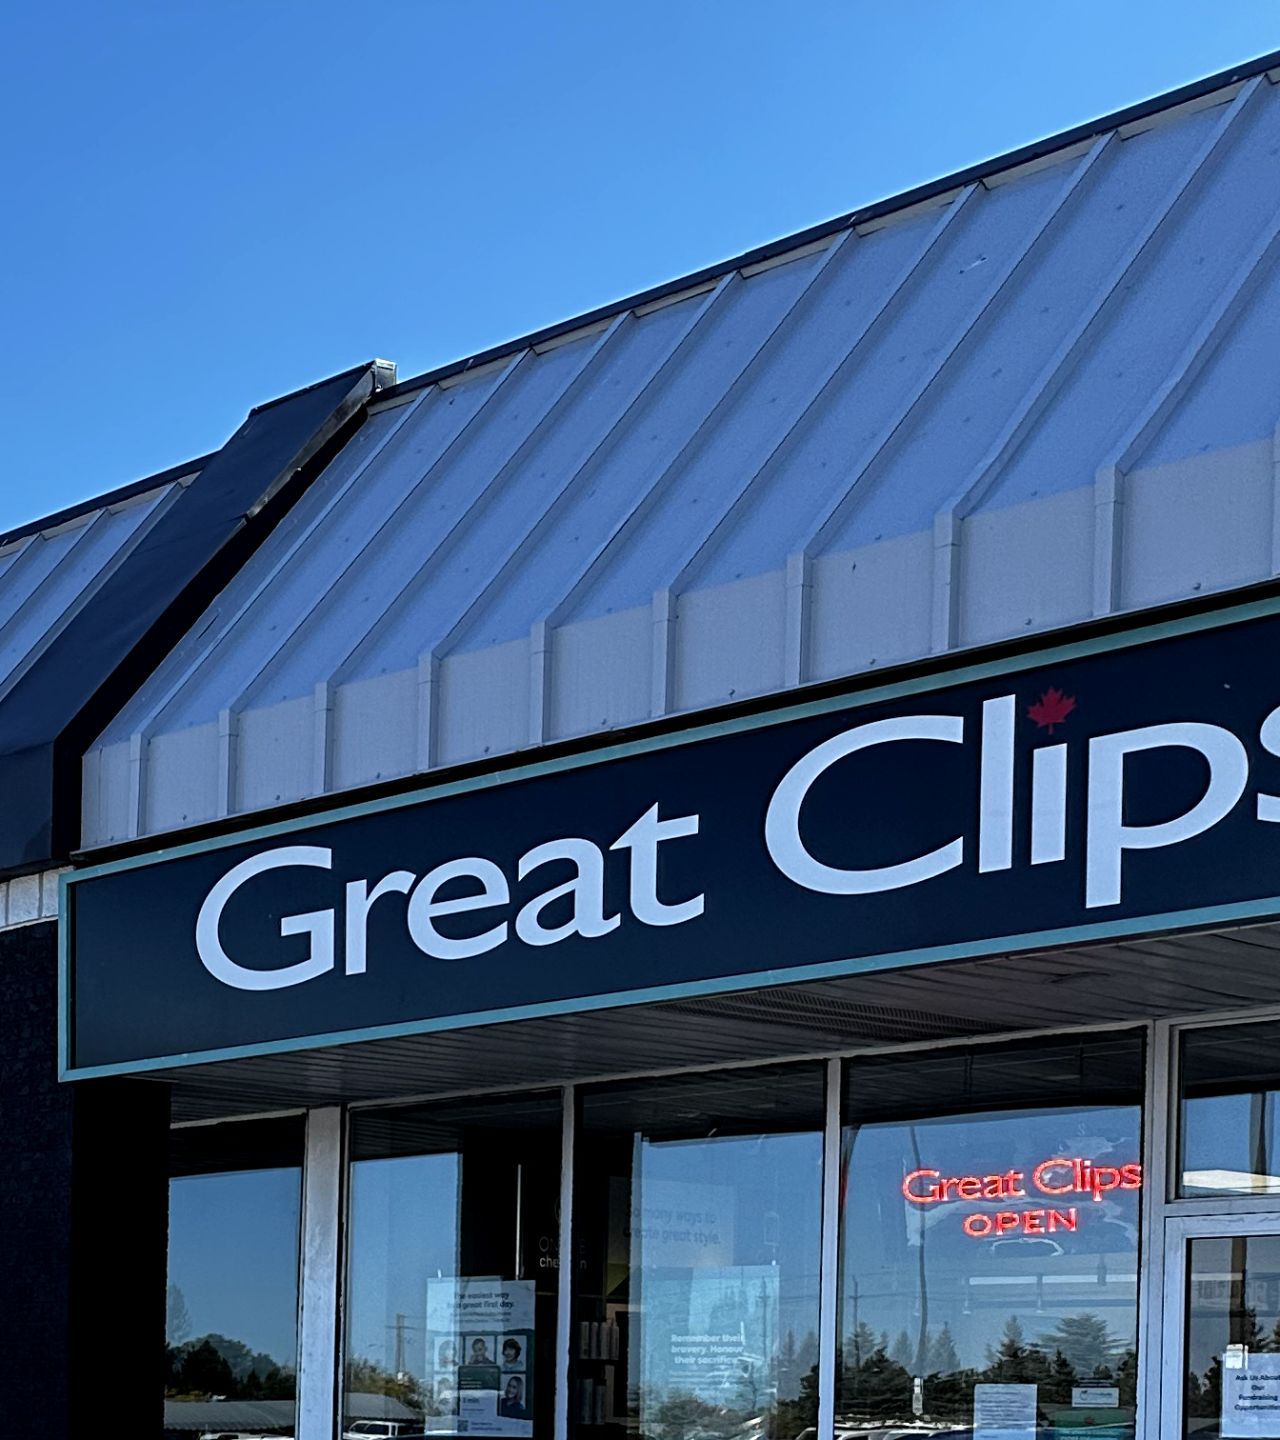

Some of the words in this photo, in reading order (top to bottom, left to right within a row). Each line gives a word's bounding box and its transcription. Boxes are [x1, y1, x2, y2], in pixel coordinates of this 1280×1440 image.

[195, 802, 705, 992] Great
[902, 1168, 1026, 1204] Great
[1032, 1157, 1142, 1202] Clips
[963, 1208, 1078, 1238] OPEN
